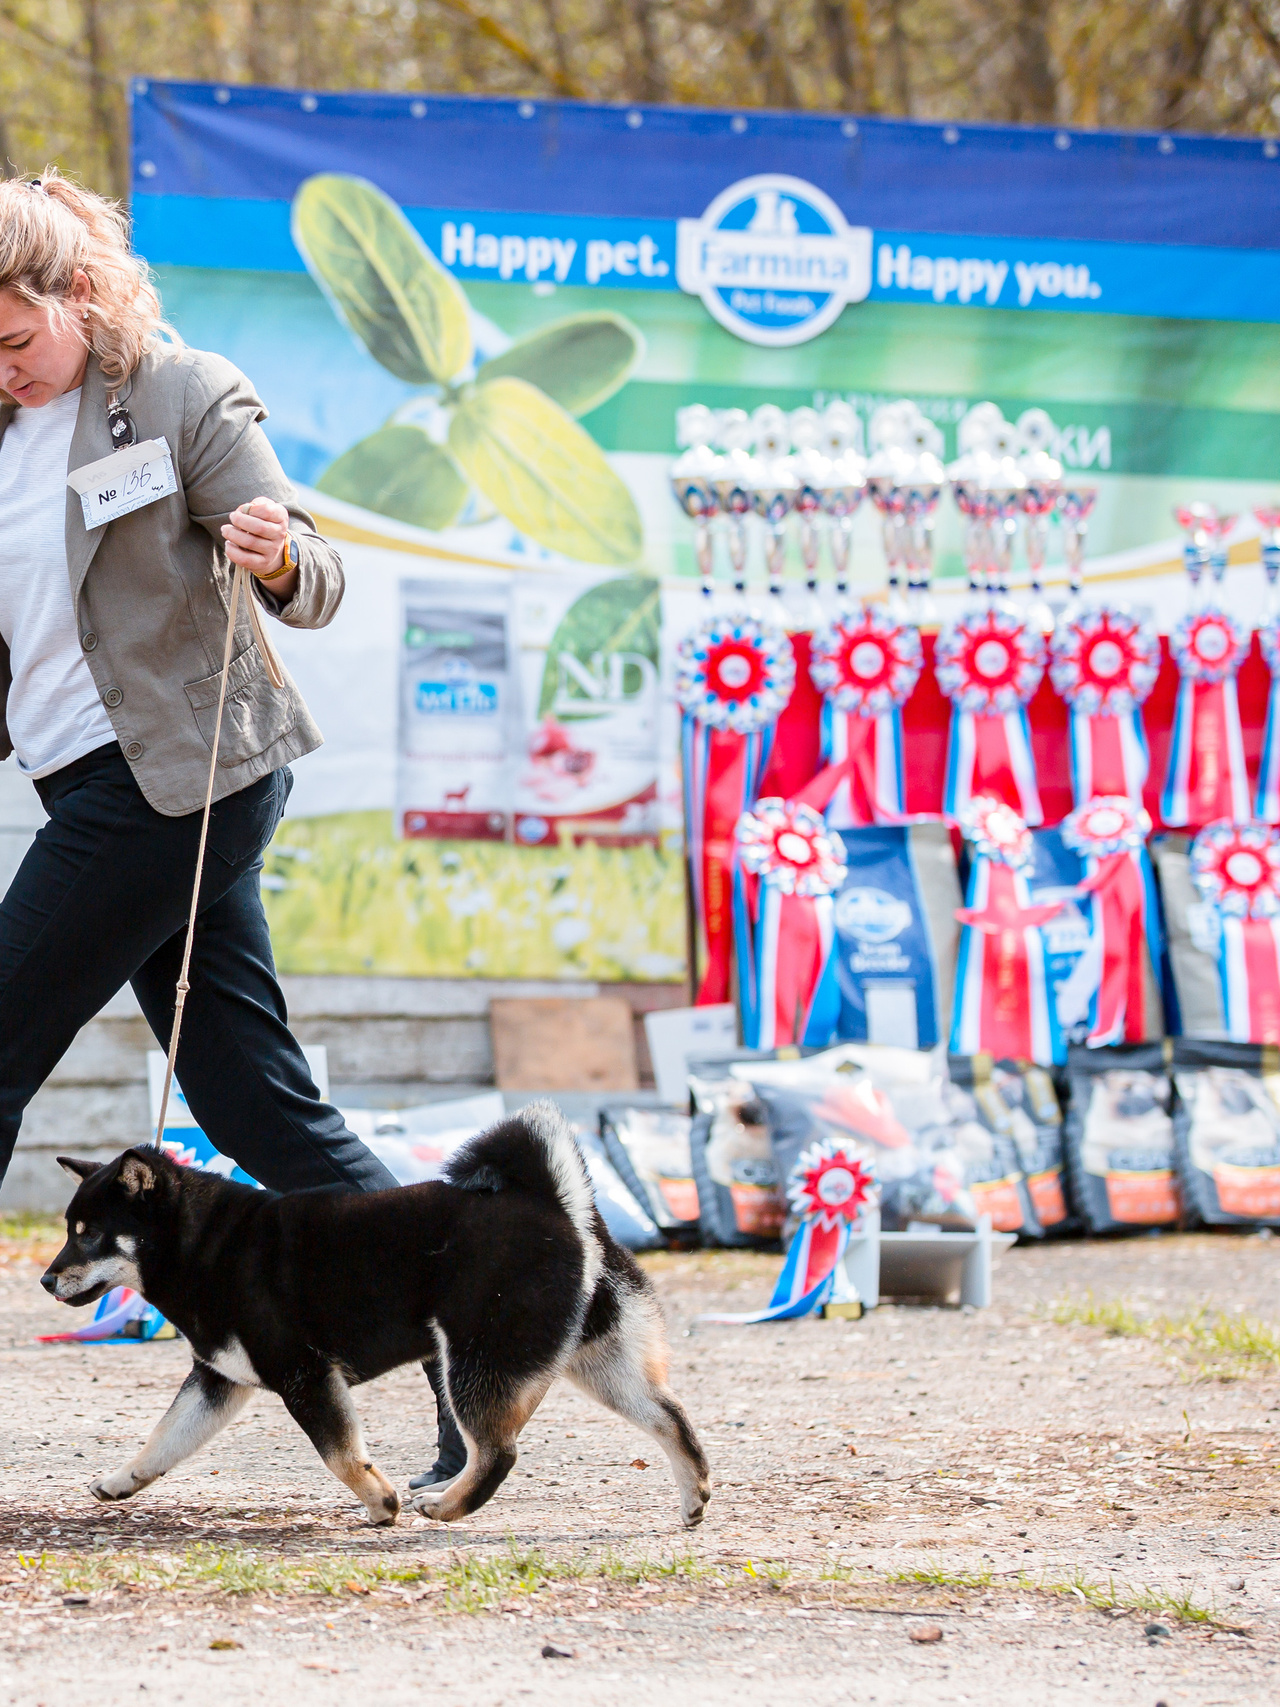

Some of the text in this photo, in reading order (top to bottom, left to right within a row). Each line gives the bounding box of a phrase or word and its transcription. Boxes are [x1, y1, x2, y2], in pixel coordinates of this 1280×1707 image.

[440, 221, 670, 284] Happy pet.
[700, 240, 849, 281] Farmina
[877, 244, 1103, 307] Happy you.
[122, 463, 152, 497] 136
